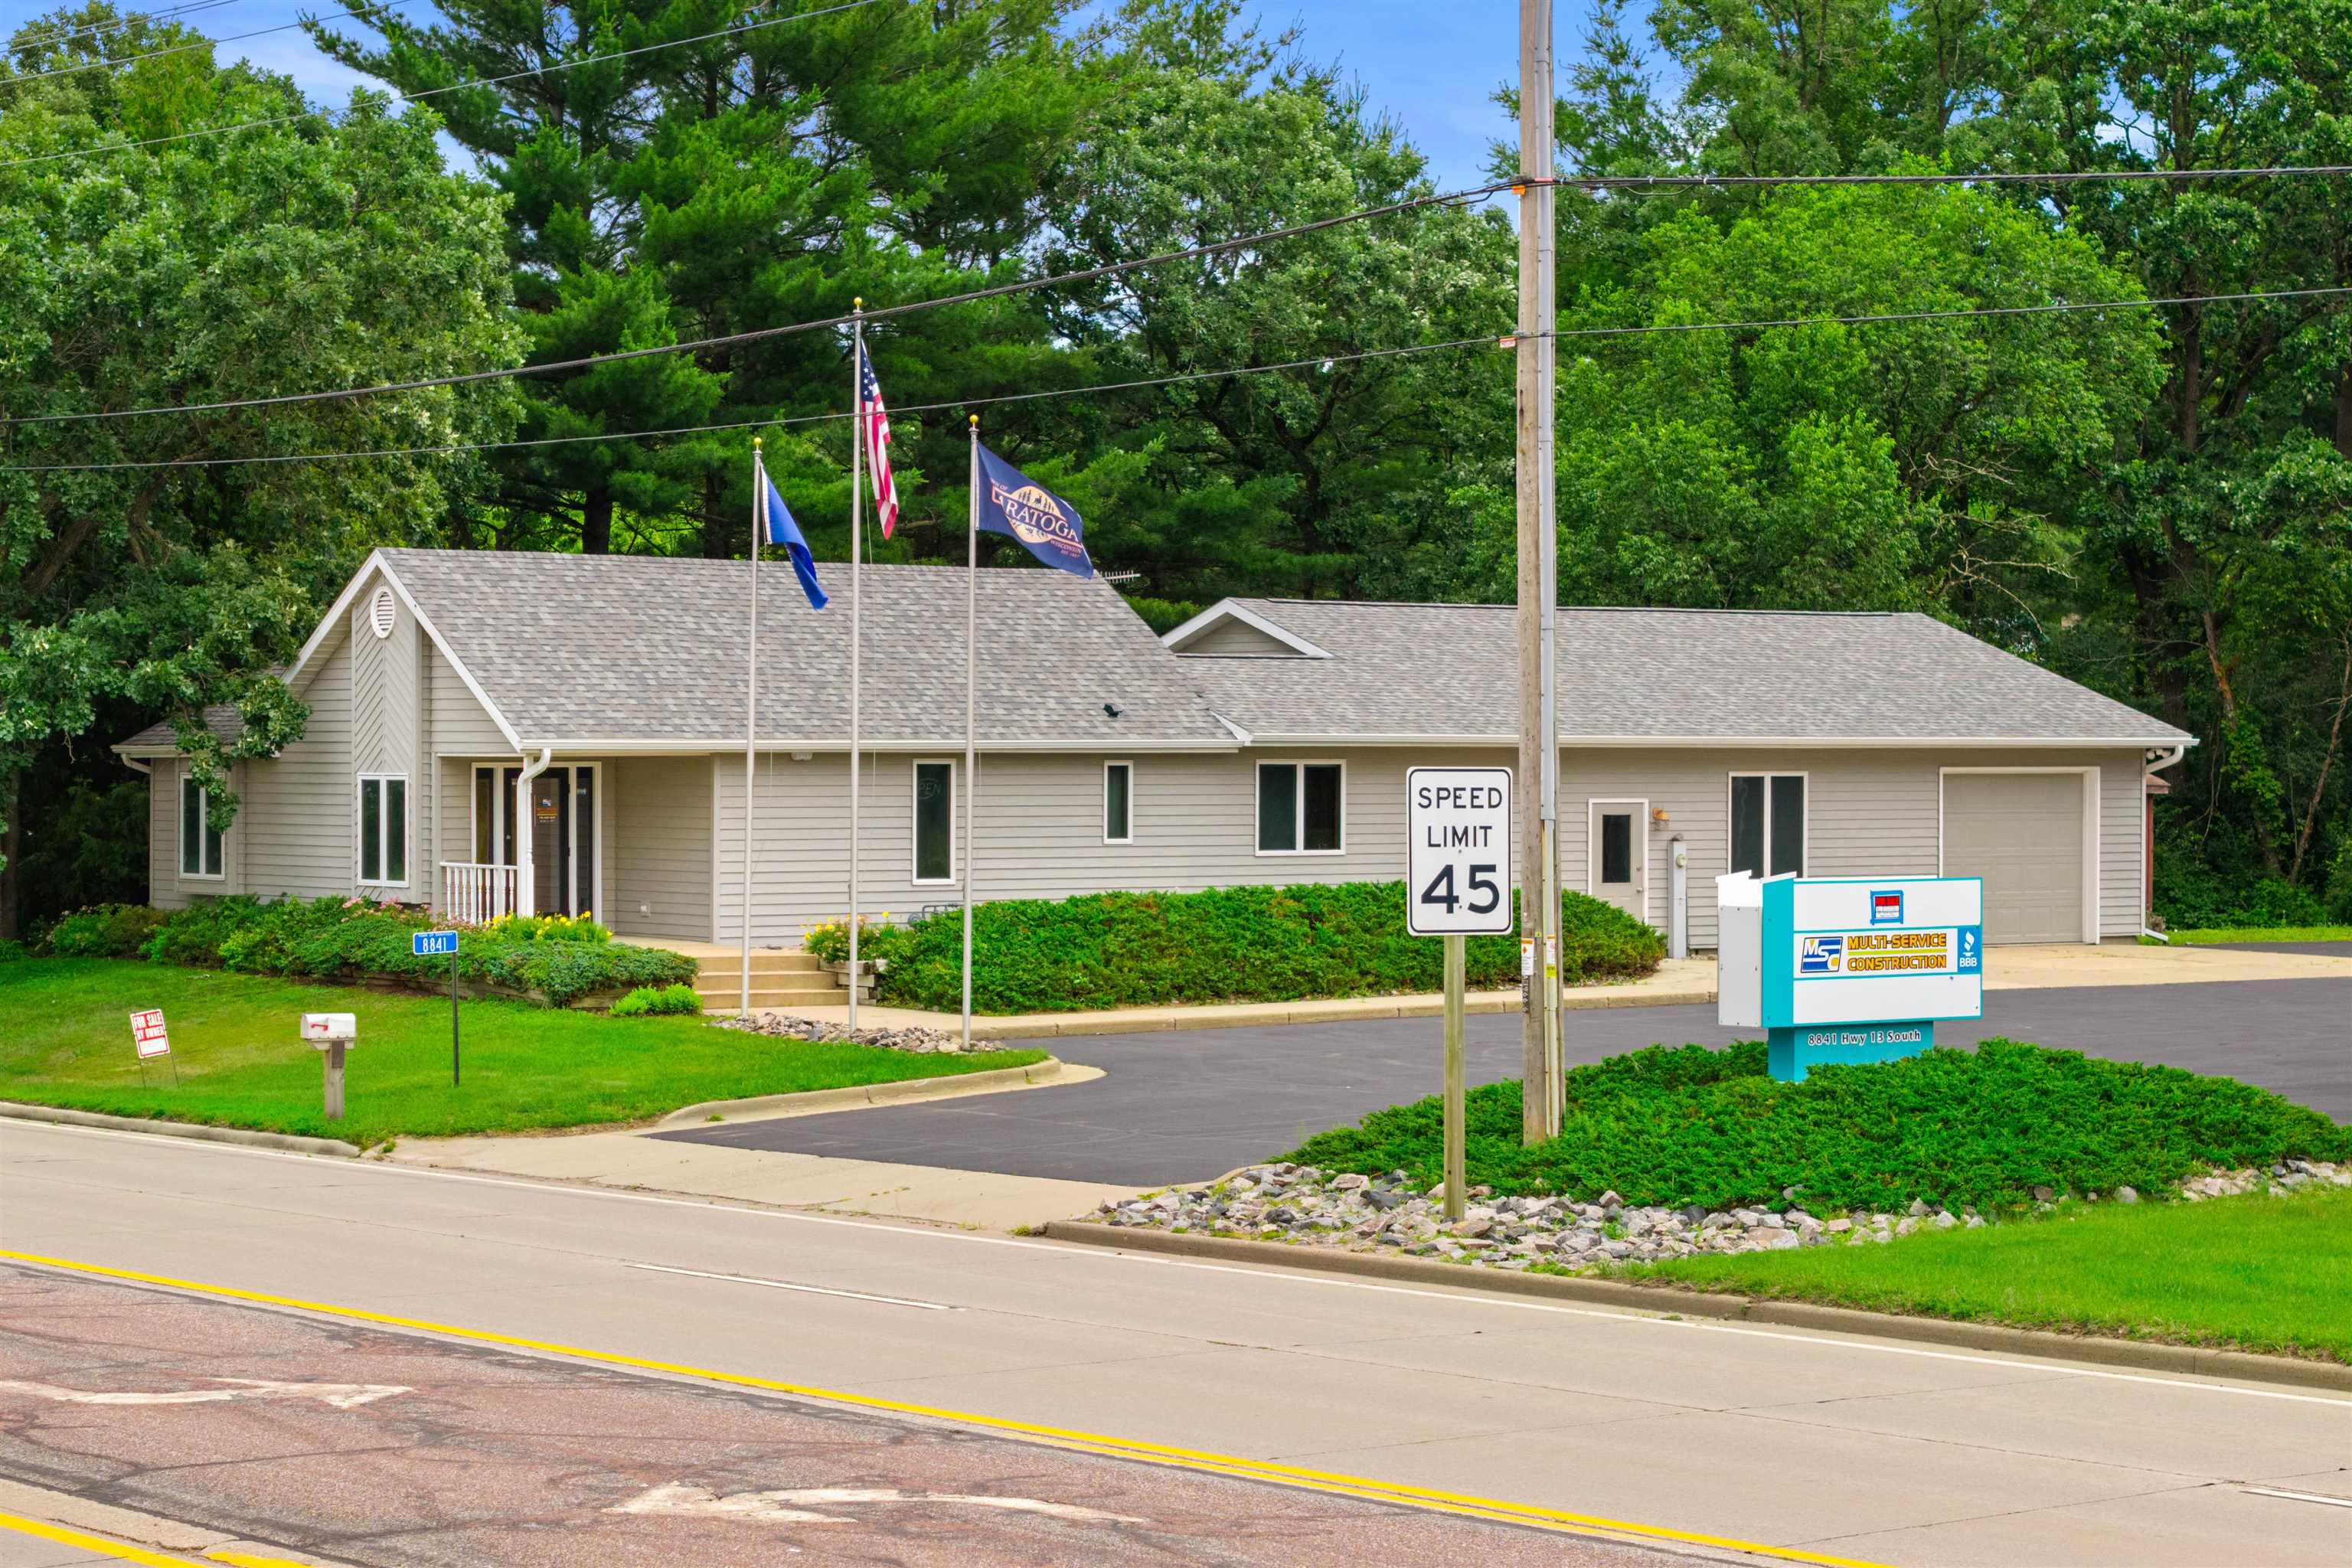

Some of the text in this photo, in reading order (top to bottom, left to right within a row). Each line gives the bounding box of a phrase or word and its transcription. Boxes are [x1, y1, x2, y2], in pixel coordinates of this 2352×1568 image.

[1418, 786, 1502, 809] SPEED
[1427, 825, 1492, 848] LIMIT
[1421, 864, 1500, 914] 45
[423, 937, 446, 952] 8841
[1847, 933, 1947, 950] MULTI-SERVICE
[1803, 938, 1841, 971] MSC
[1959, 957, 1978, 968] BBB
[1847, 955, 1947, 972] CONSTRUCTION
[146, 1012, 162, 1027] SALE
[1808, 1029, 1921, 1046] 8841 Hwy 13 South
